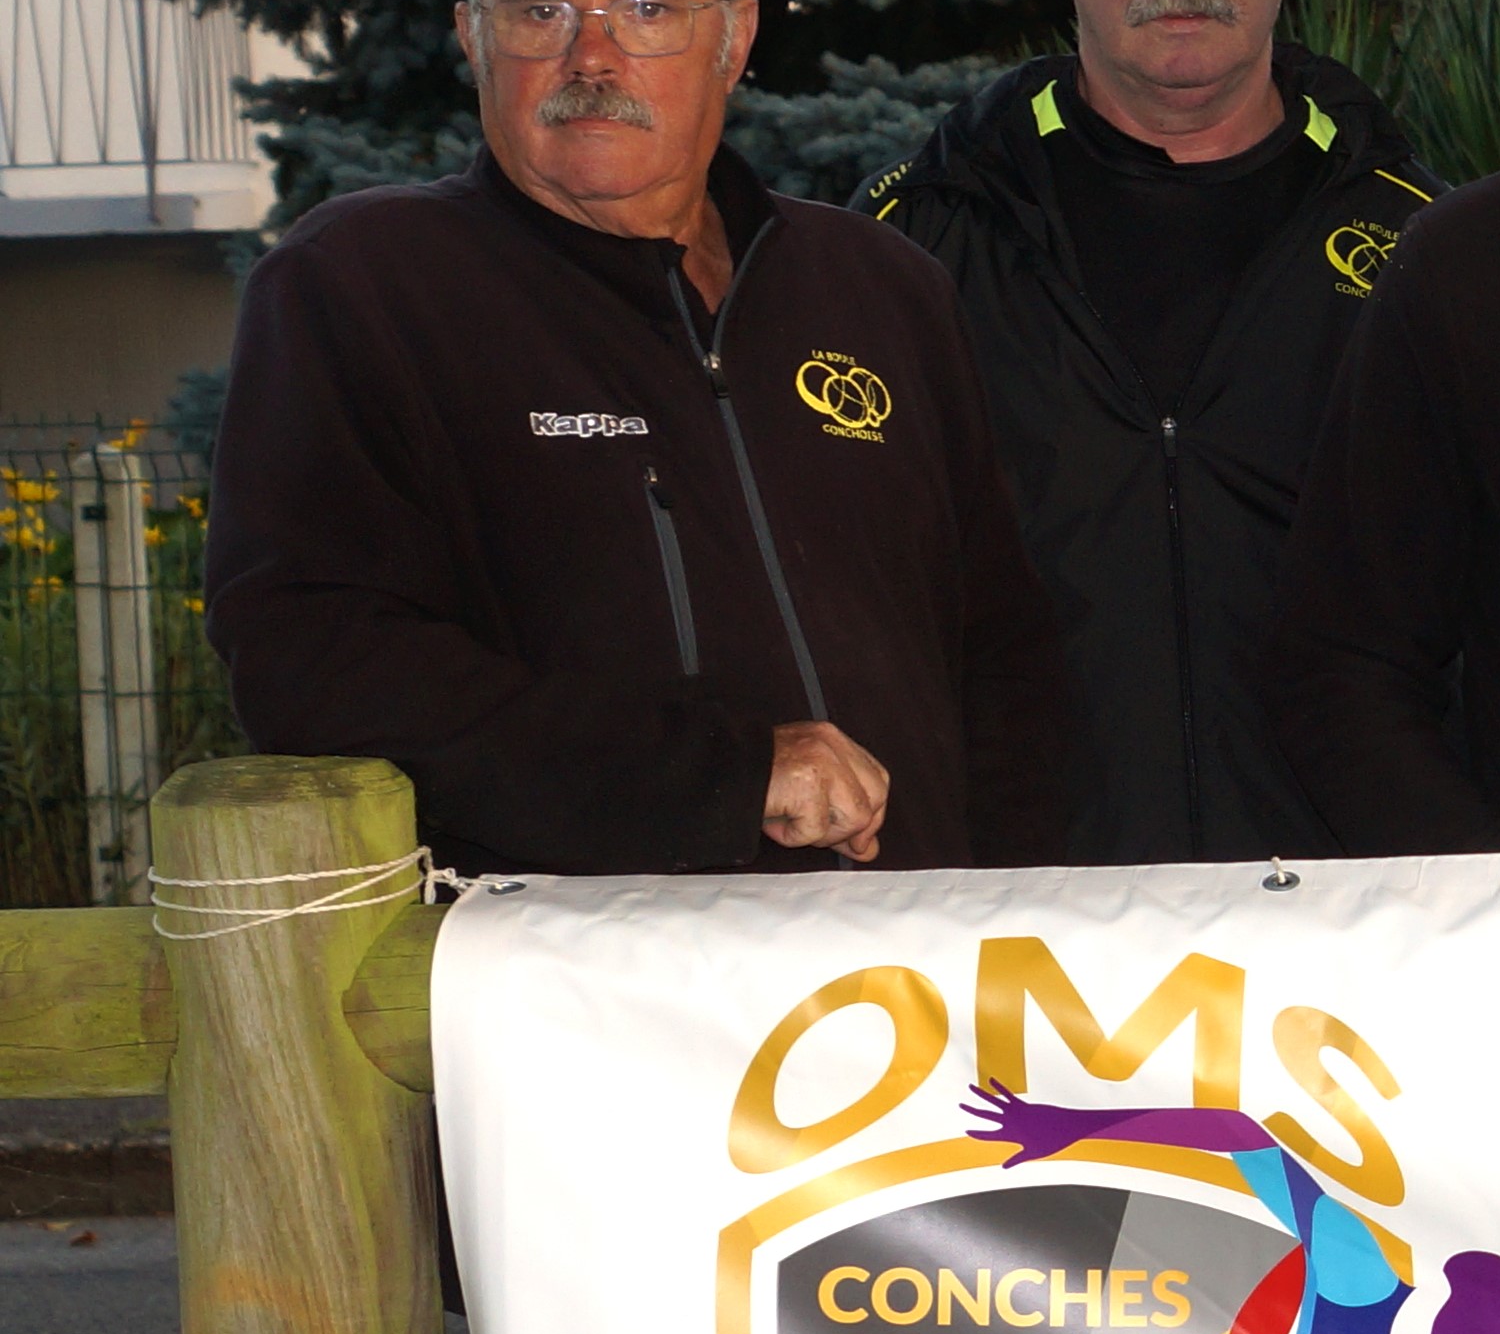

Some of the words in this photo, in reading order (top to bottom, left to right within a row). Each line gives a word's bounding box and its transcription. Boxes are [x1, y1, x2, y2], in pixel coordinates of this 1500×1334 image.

[1352, 218, 1366, 231] LA
[1369, 222, 1400, 241] BOULE
[811, 349, 825, 360] LA
[530, 411, 649, 438] Kappa
[822, 424, 886, 444] CONCHOISE
[728, 936, 1405, 1207] OMS
[817, 1265, 1192, 1328] CONCHES
